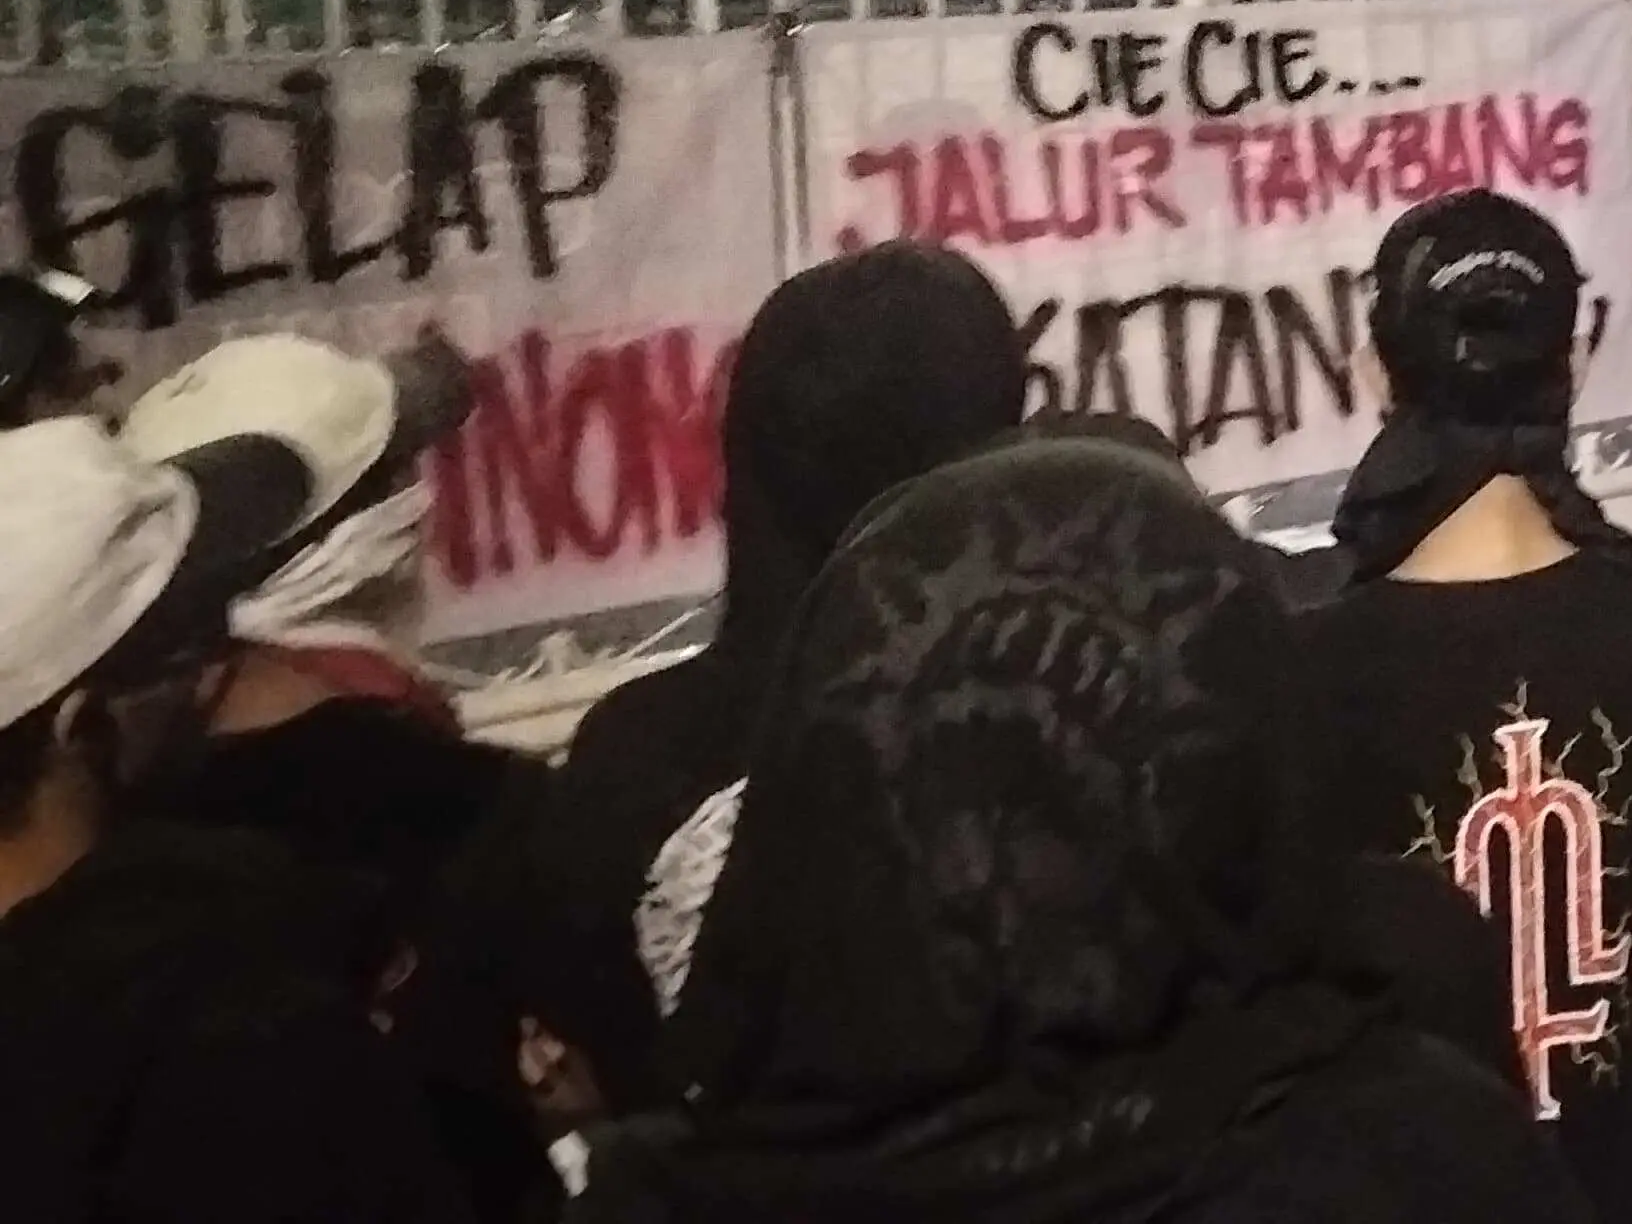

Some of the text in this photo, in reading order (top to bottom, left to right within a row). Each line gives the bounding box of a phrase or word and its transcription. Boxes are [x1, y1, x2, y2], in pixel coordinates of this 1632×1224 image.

[1012, 21, 1166, 122] CIE
[14, 50, 622, 331] GELAP
[835, 90, 1592, 254] JALUR TAMBANG
